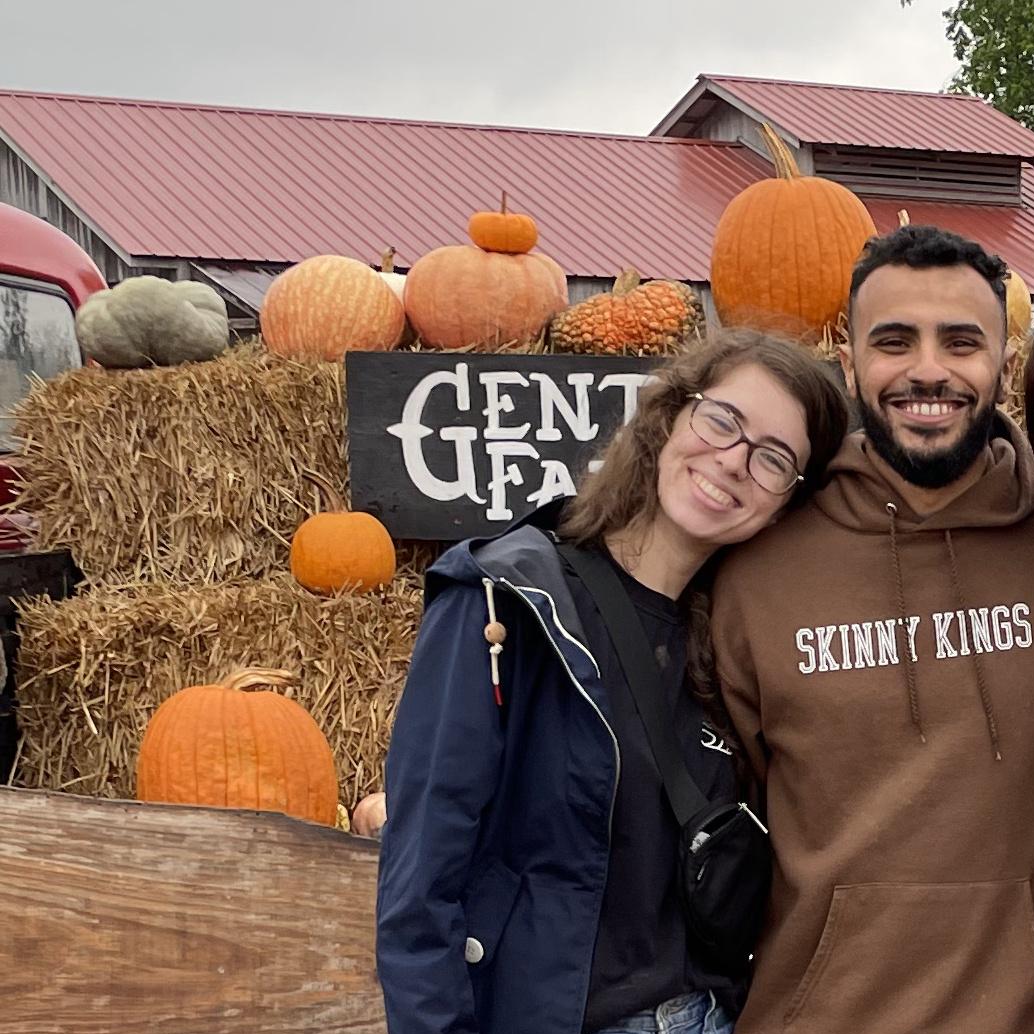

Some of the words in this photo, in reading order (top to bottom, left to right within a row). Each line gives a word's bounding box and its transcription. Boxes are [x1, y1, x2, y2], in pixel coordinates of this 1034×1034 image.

[387, 363, 662, 504] GENT
[486, 442, 606, 521] FA
[795, 615, 921, 674] SKINNY
[932, 603, 1033, 659] KINGS
